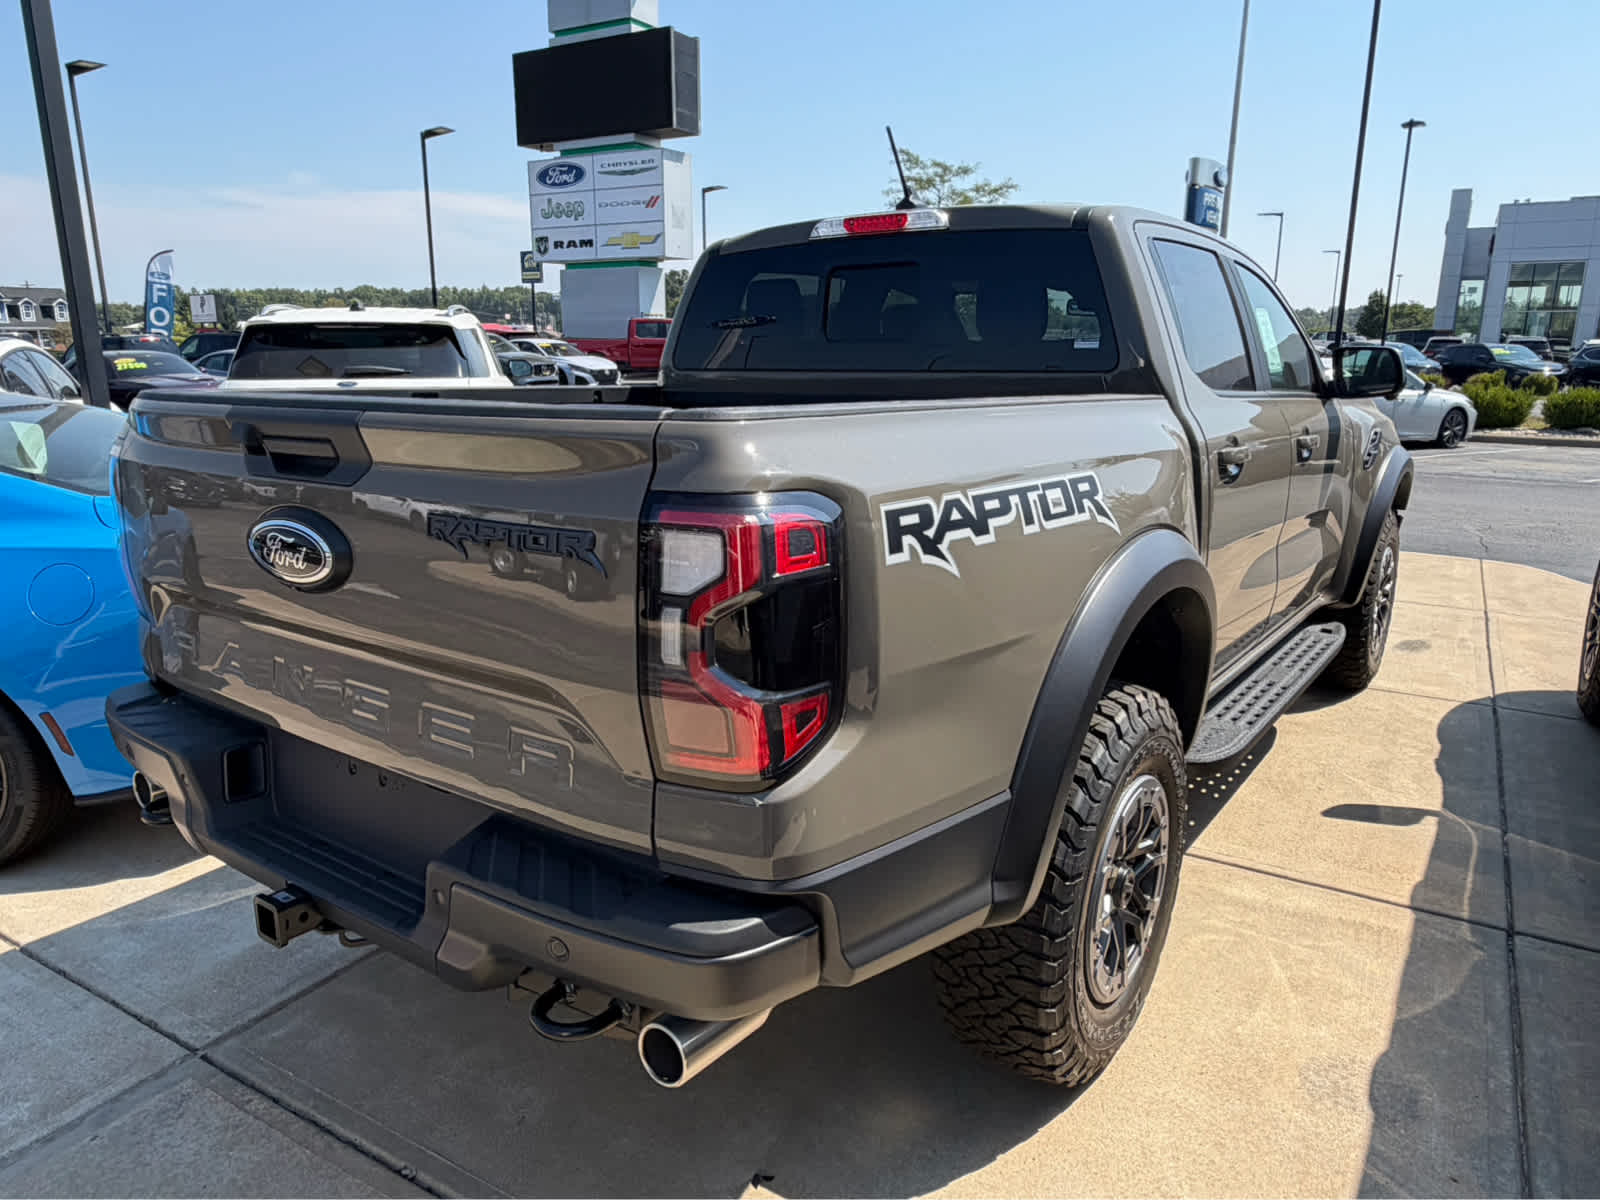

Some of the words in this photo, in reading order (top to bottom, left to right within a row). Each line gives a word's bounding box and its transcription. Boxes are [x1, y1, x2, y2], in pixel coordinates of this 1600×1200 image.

[546, 166, 577, 184] Ford
[600, 158, 656, 169] CHRYSLER
[541, 198, 584, 221] Jeep
[553, 238, 594, 250] RAM
[880, 471, 1121, 578] RAPTOR
[263, 531, 308, 570] Ford
[426, 513, 607, 579] RAPTOR
